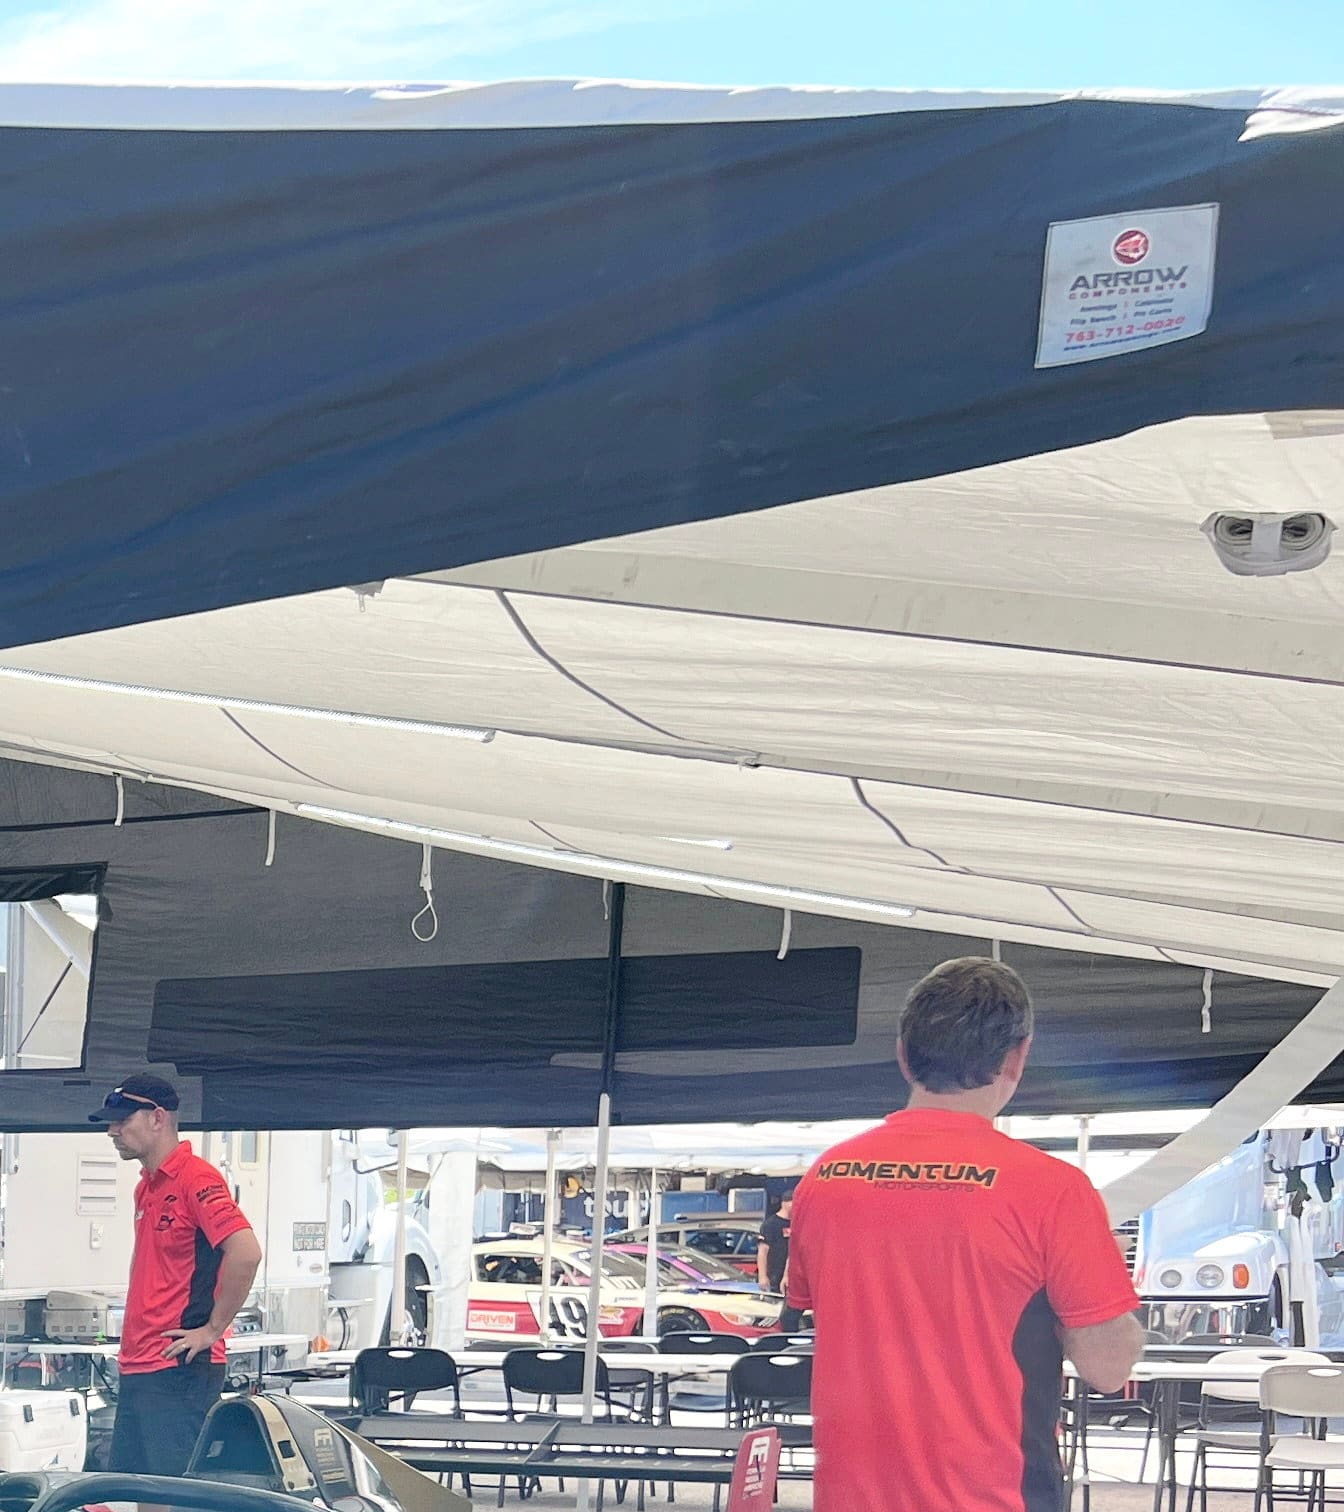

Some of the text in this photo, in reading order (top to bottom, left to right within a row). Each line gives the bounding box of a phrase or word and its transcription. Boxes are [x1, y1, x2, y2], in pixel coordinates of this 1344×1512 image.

[1070, 266, 1188, 291] ARROW
[1069, 282, 1187, 300] COMPONENTS
[818, 1161, 997, 1187] MOMENTUM
[874, 1181, 976, 1193] MOTORSPORTS
